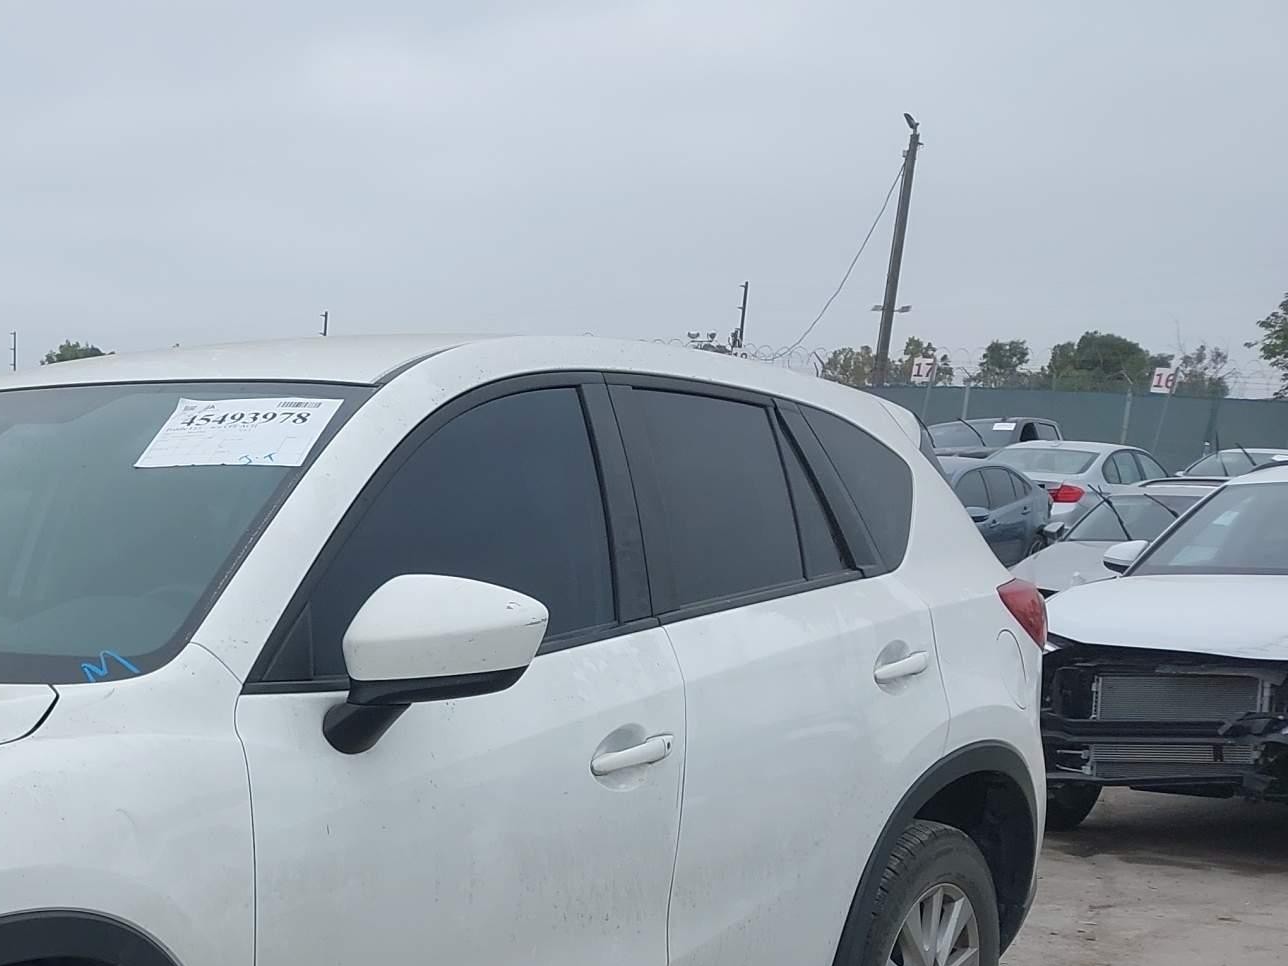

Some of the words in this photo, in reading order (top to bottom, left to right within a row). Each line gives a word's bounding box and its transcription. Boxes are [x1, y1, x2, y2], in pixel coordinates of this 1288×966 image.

[913, 362, 933, 378] 17
[1153, 373, 1177, 389] 16
[180, 411, 312, 427] 45493978
